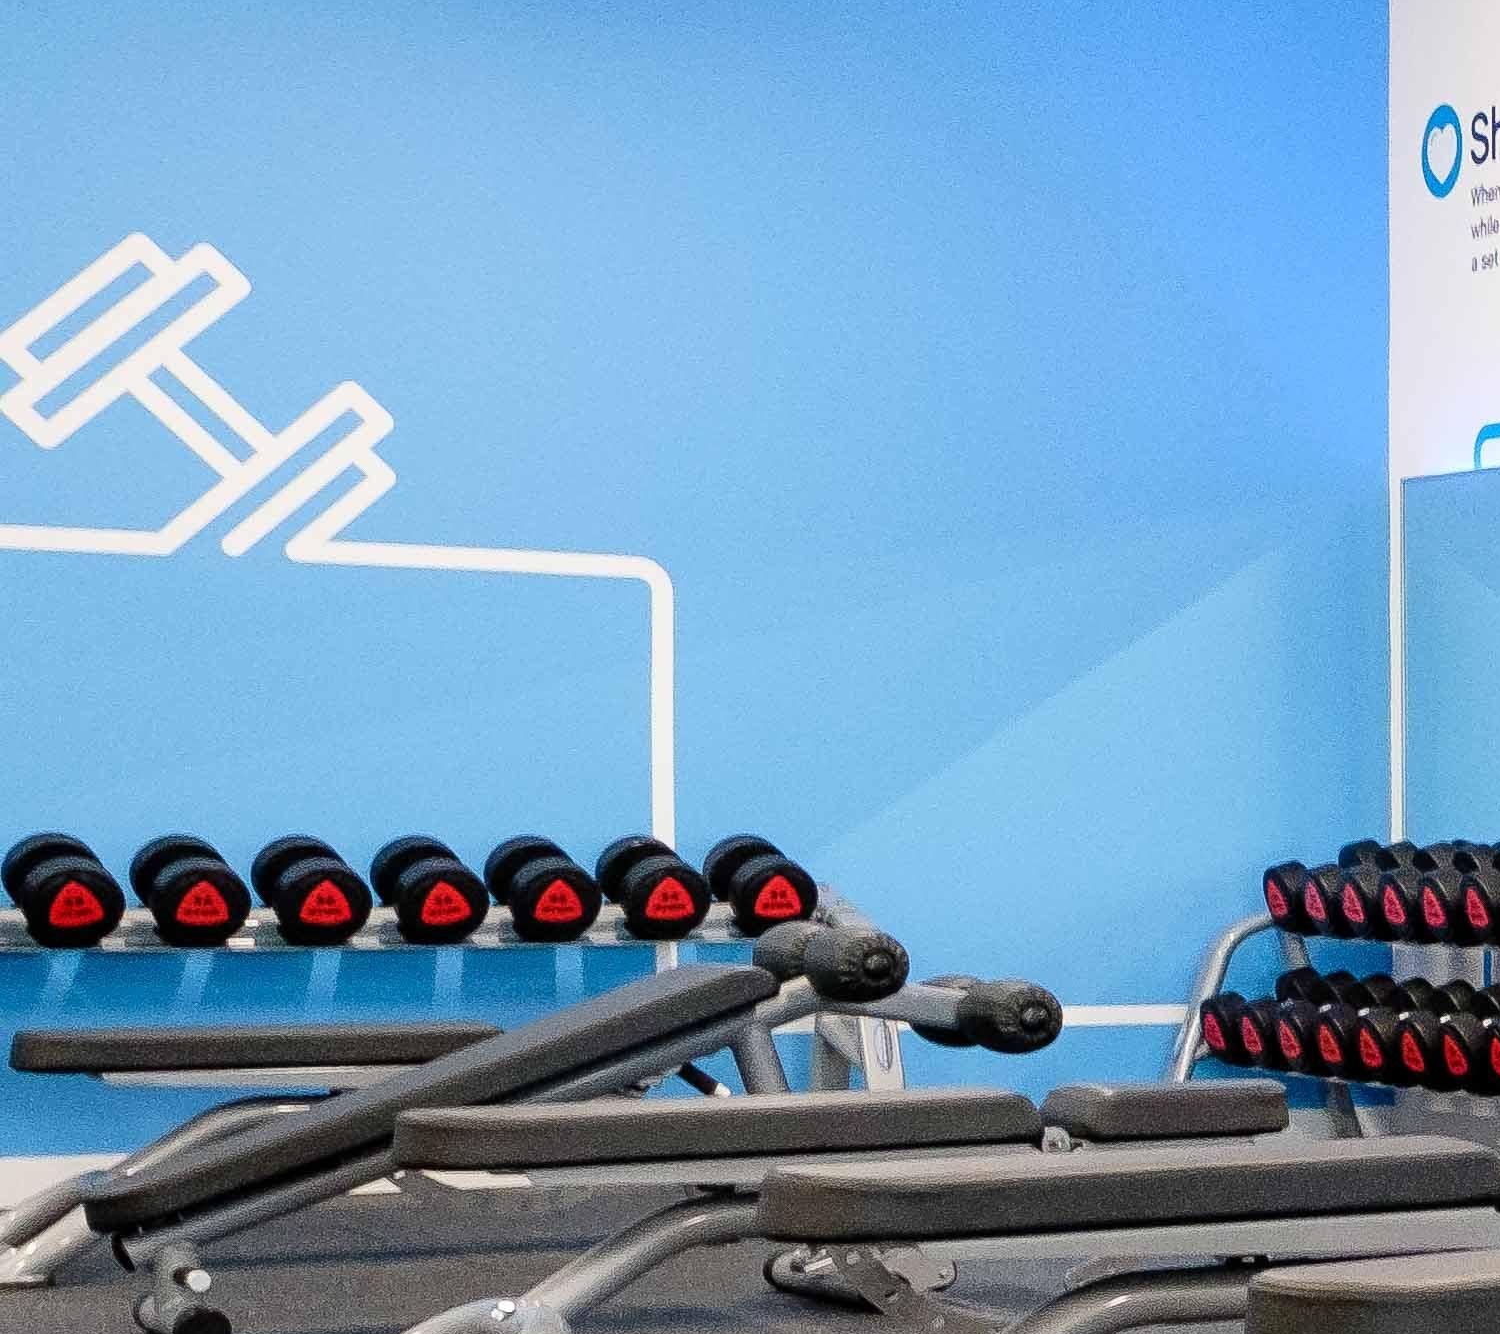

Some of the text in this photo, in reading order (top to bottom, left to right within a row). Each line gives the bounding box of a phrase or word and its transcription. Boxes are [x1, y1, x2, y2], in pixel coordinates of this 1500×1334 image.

[1471, 216, 1499, 239] while
[1472, 257, 1477, 272] a
[1482, 250, 1498, 269] set
